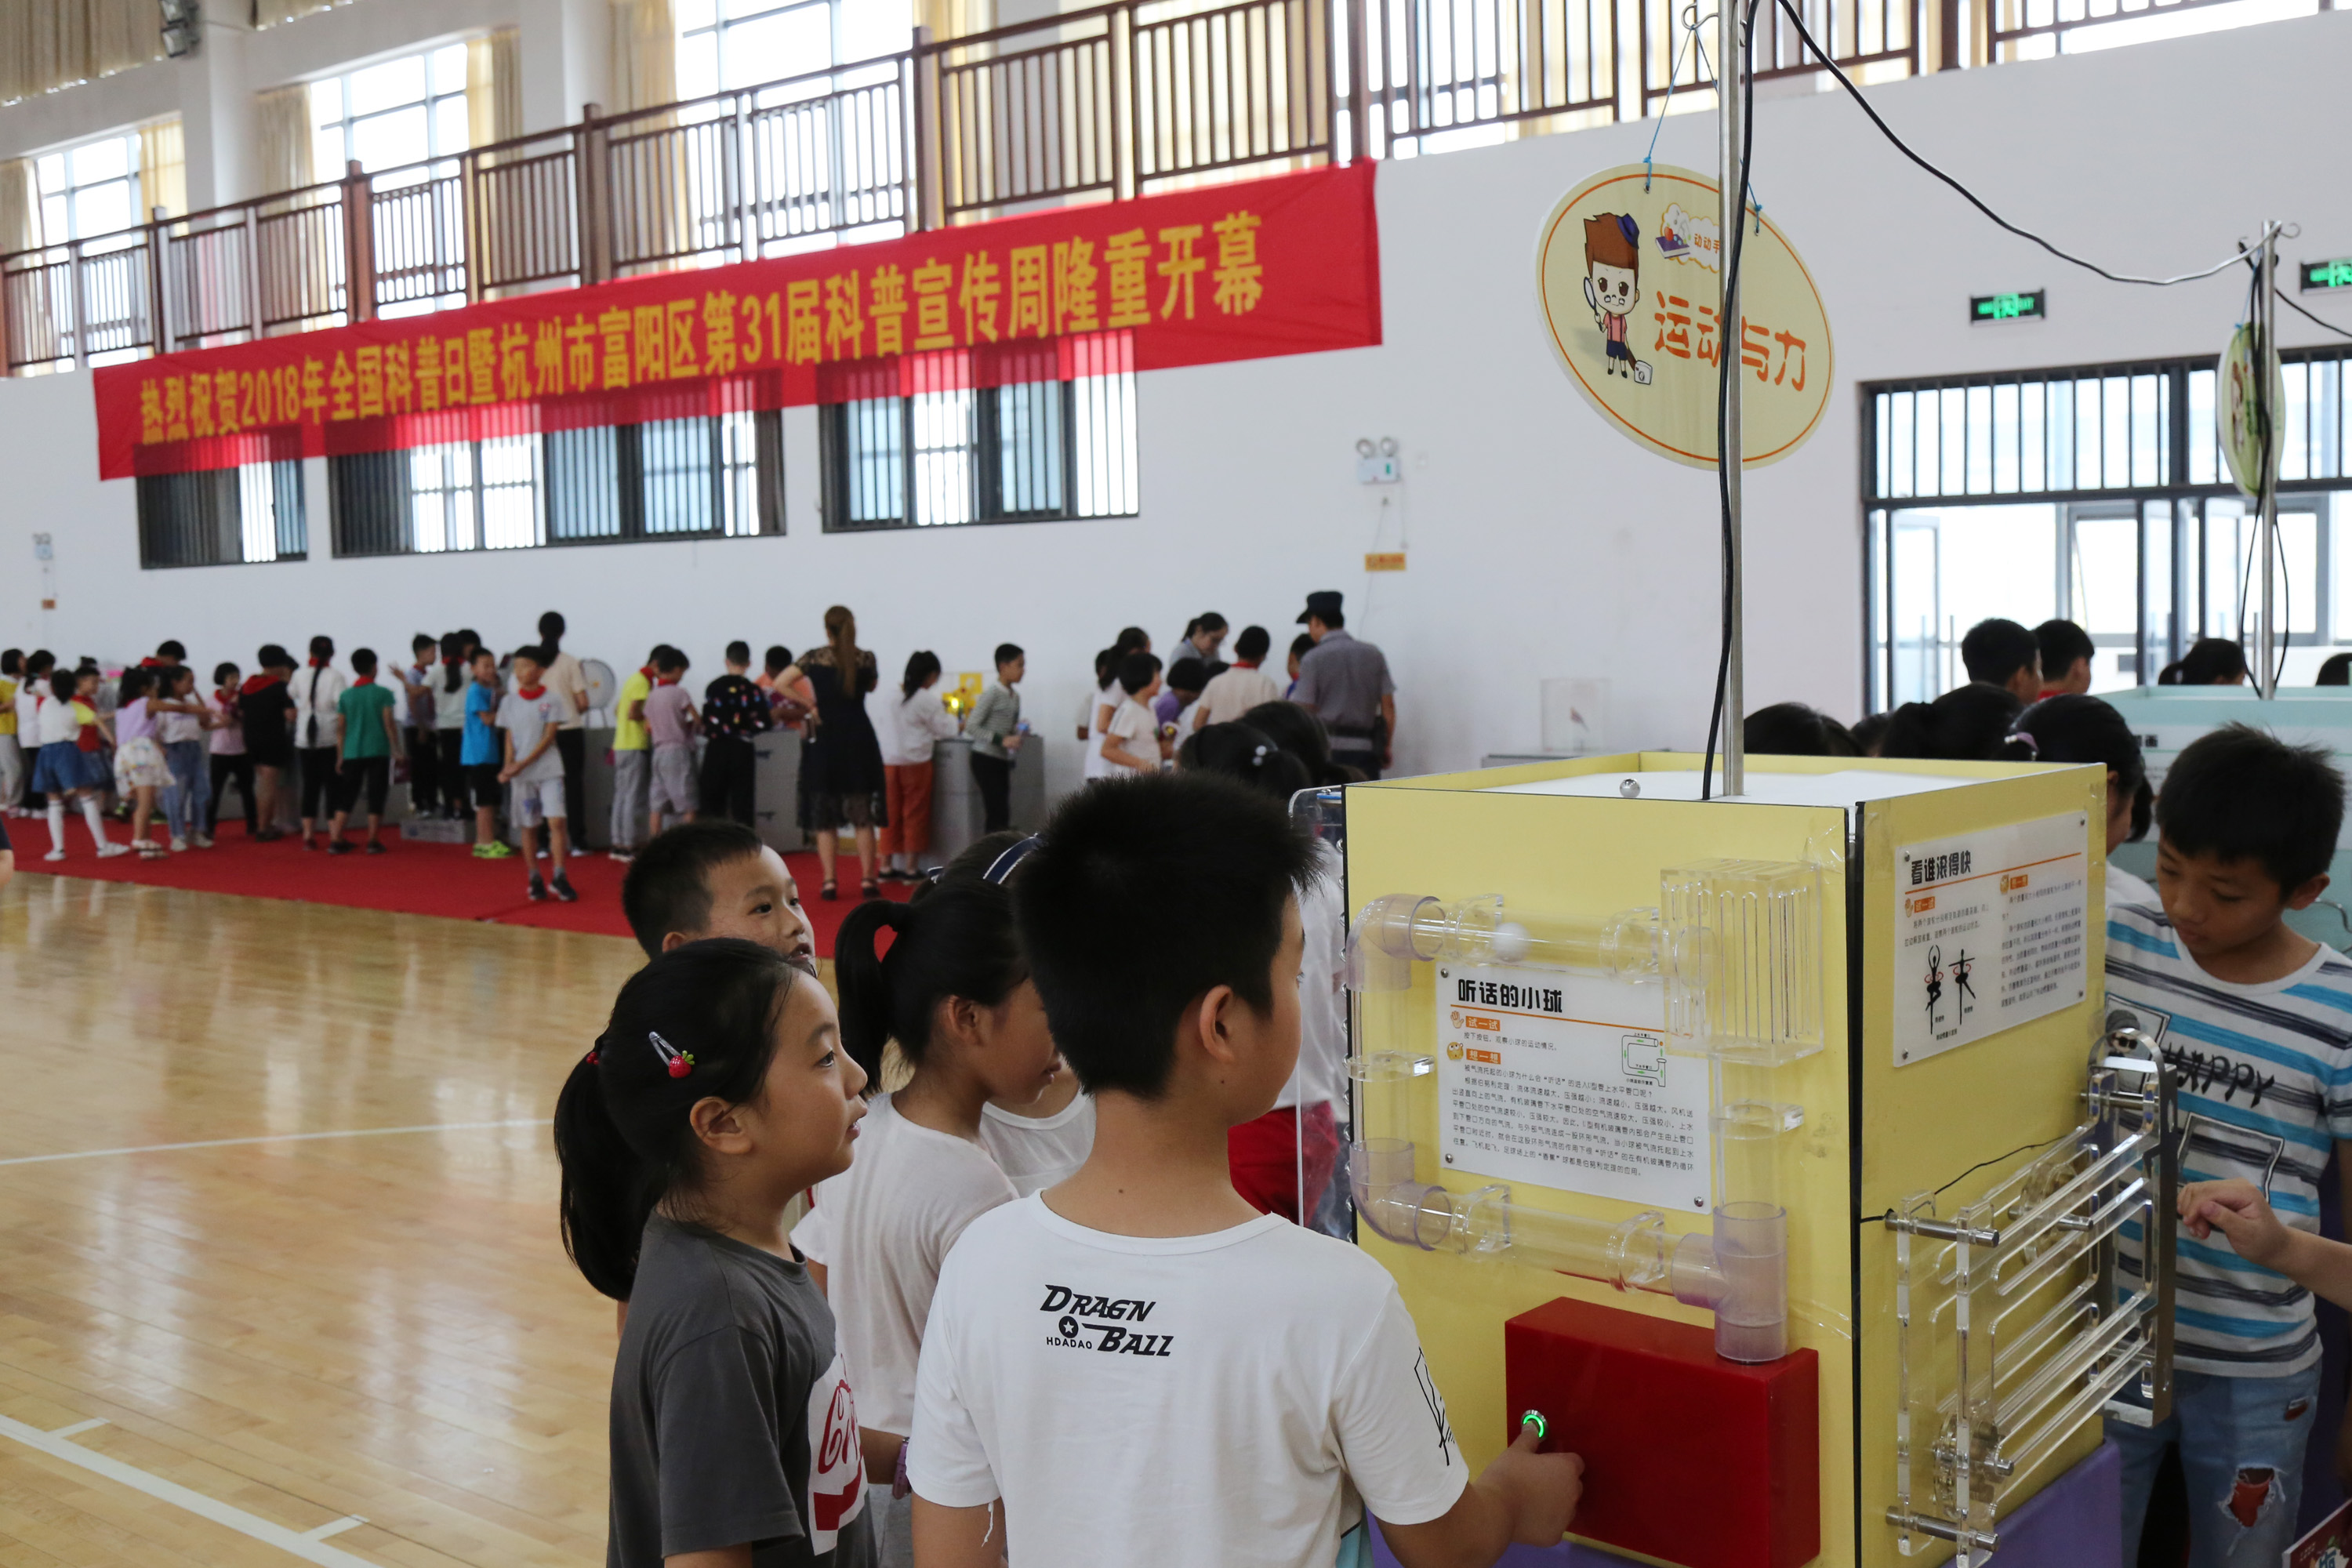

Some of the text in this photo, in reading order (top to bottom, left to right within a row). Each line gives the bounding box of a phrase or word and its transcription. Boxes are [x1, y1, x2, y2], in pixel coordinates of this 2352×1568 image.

[140, 209, 1264, 446] 热烈祝贺2018年全国科普日暨杭州市富阳区第31届科普宣传周隆重开幕
[1653, 290, 1806, 392] 运动与力
[1911, 849, 1971, 885] 看谁滚得快
[1458, 978, 1563, 1013] 听话的小球
[1468, 1017, 1498, 1031] 试一试
[1469, 1050, 1499, 1064] 想一想
[1040, 1284, 1156, 1322] DRAGN
[1046, 1337, 1092, 1349] HDADAO
[1081, 1323, 1174, 1357] BALL
